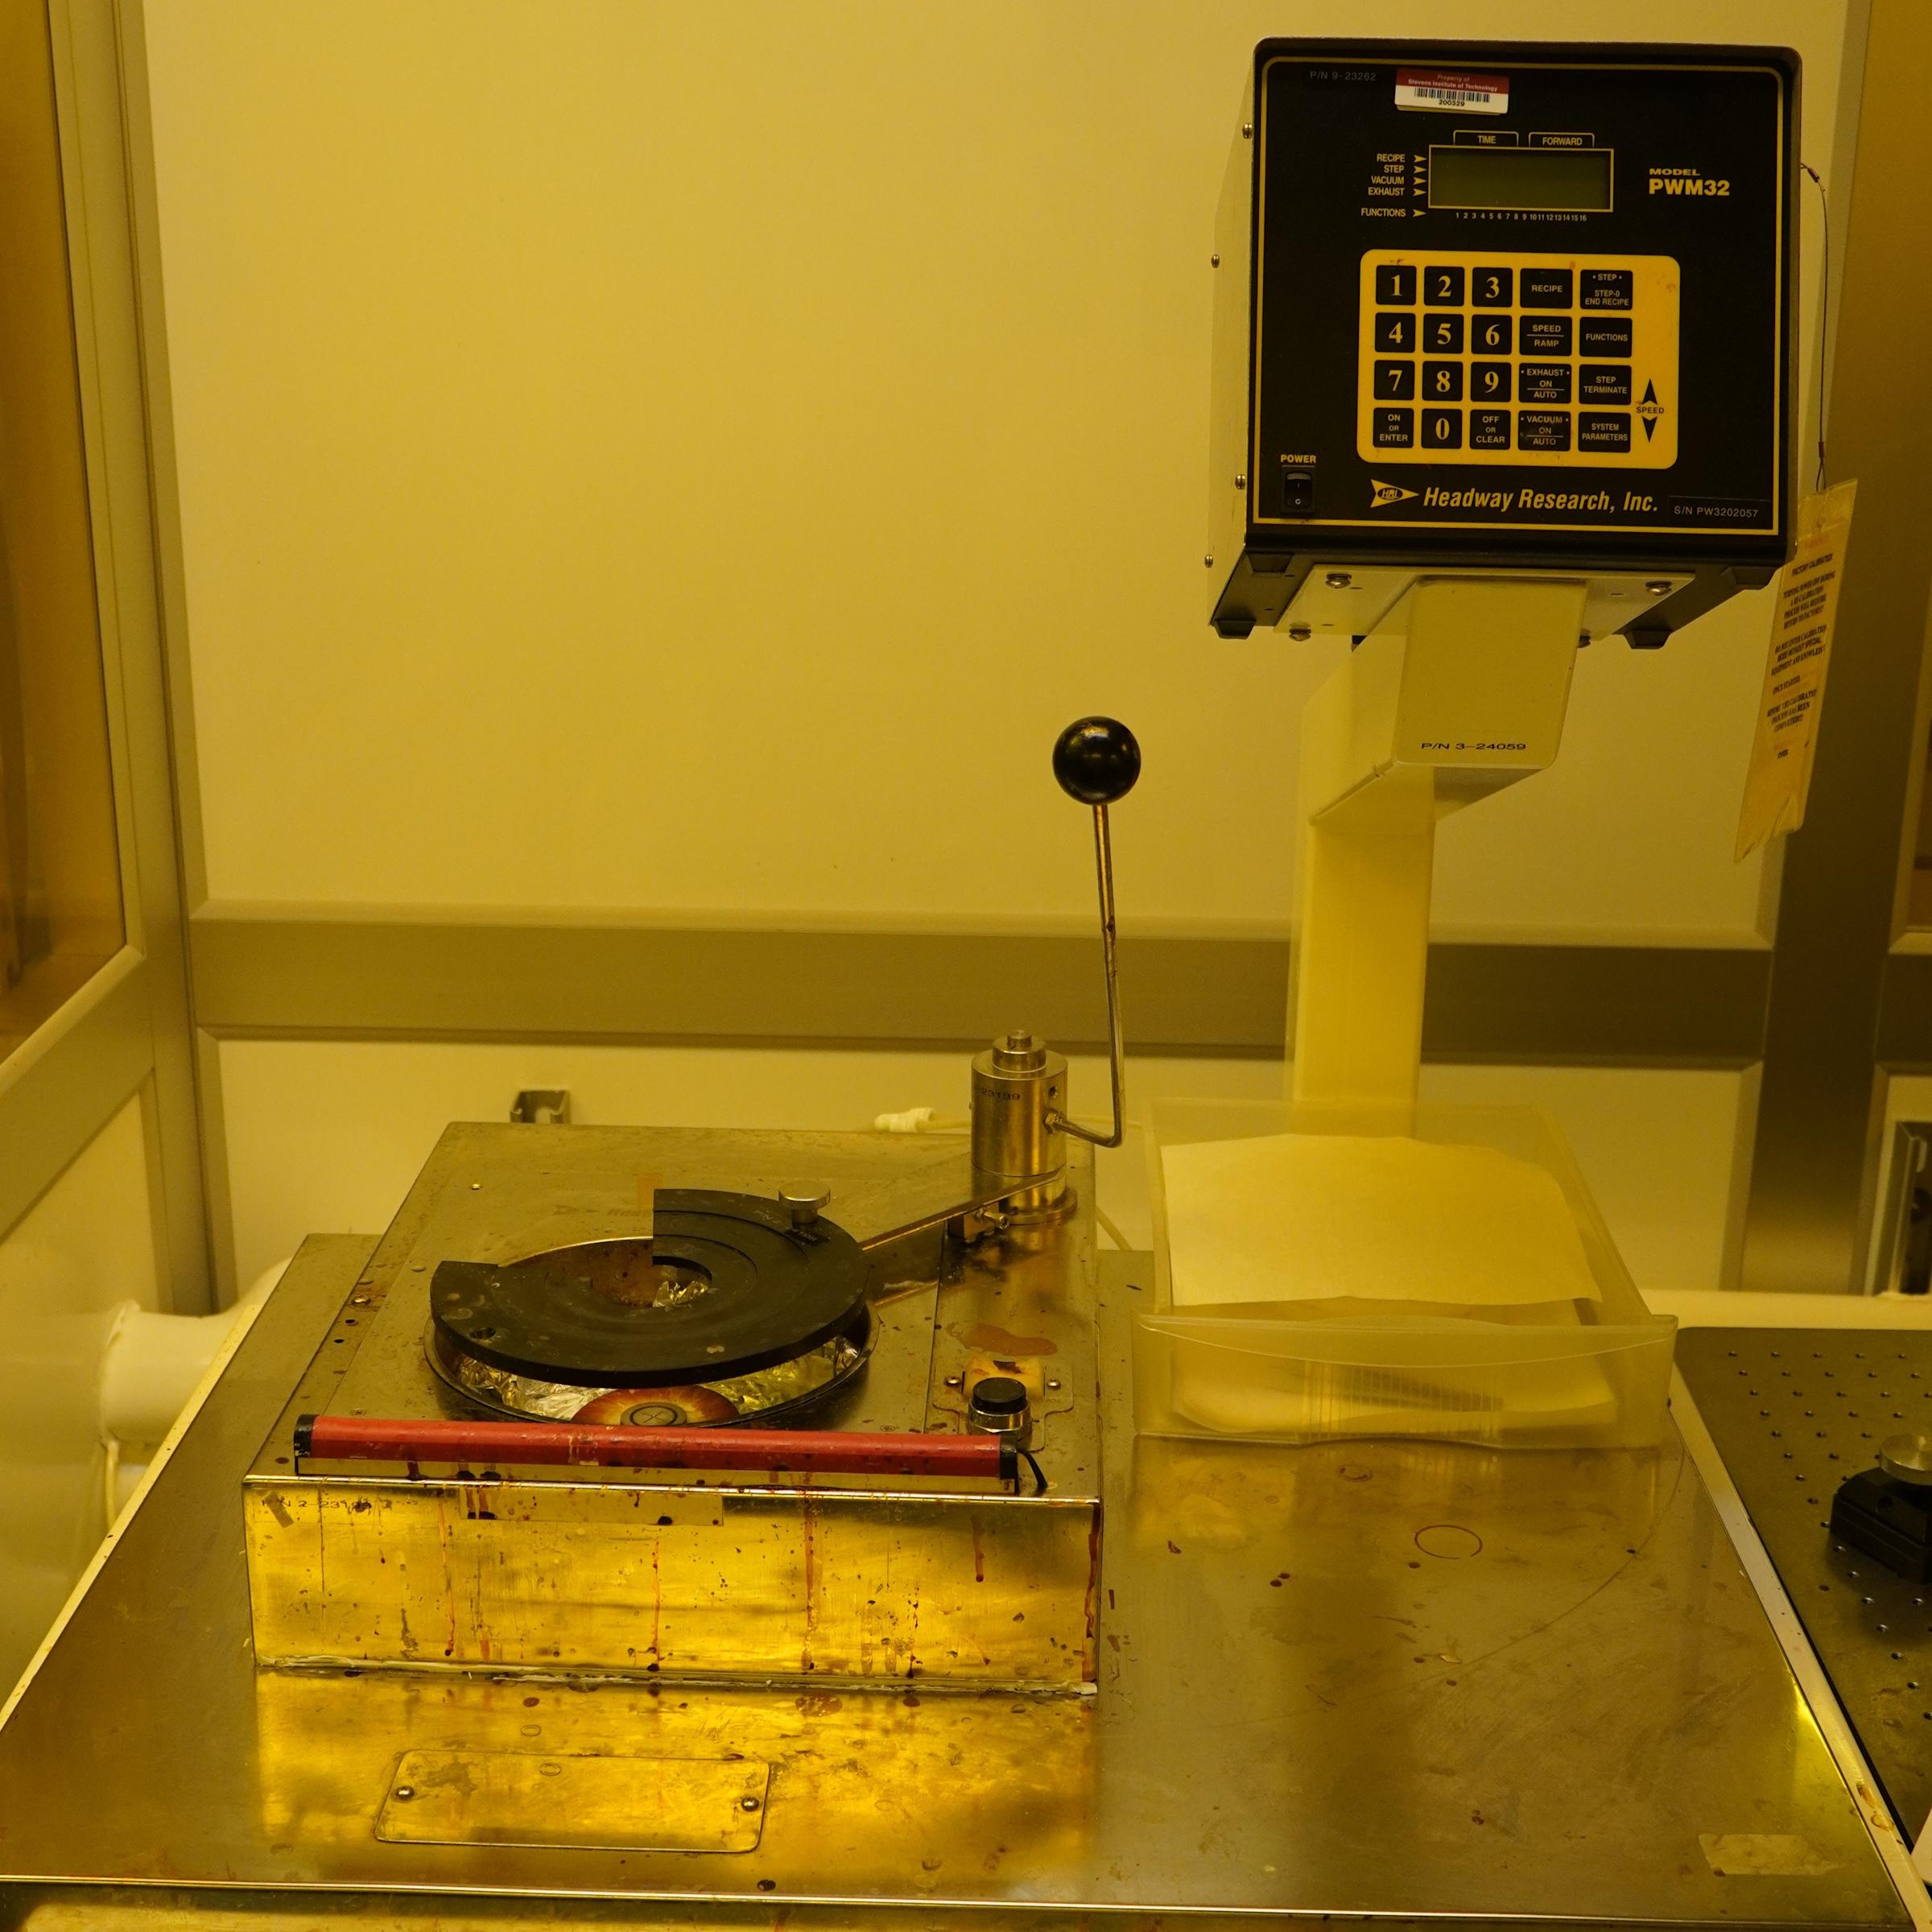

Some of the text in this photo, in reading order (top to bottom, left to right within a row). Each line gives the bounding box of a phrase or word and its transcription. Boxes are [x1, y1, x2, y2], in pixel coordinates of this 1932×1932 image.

[1310, 71, 1328, 79] P/N
[1437, 74, 1462, 82] Property
[1465, 84, 1498, 92] Technology
[1439, 99, 1465, 107] 200329
[1478, 135, 1496, 144] TIME
[1542, 137, 1583, 146] FORWARD
[1377, 154, 1406, 163] RECIPE
[1384, 164, 1405, 173] STEP
[1371, 176, 1405, 185] VACUUM
[1368, 187, 1405, 196] EXHAUST
[1649, 178, 1730, 196] PWM32
[1361, 208, 1406, 217] FUNCTIONS
[1391, 275, 1402, 296] 1
[1438, 275, 1452, 297] 2
[1485, 276, 1500, 298] 3
[1602, 298, 1629, 306] RECIPE
[1532, 324, 1562, 332] SPEED
[1389, 322, 1403, 344] 4
[1437, 323, 1451, 345] 5
[1485, 324, 1500, 346] 6
[1586, 333, 1629, 342] FUNCTIONS
[1534, 339, 1559, 347] RAMP
[1526, 368, 1564, 377] EXHAUST
[1388, 369, 1402, 391] 7
[1436, 370, 1451, 392] 8
[1484, 371, 1499, 393] 9
[1596, 376, 1616, 384] STEP
[1583, 386, 1628, 394] TERMINATE
[1636, 407, 1665, 415] SPEED
[1388, 414, 1401, 422] ON
[1482, 415, 1500, 423] OFF
[1526, 415, 1563, 423] VACUUM
[1435, 418, 1450, 440] 0
[1538, 427, 1552, 435] ON
[1591, 423, 1620, 431] SYSTEM
[1379, 434, 1409, 442] ENTER
[1476, 436, 1505, 444] CLEAR
[1582, 432, 1628, 442] PARAMETERS
[1280, 454, 1317, 464] POWER
[1423, 486, 1658, 514] Headway Research, Inc.
[1674, 506, 1759, 518] S/N PW3202057
